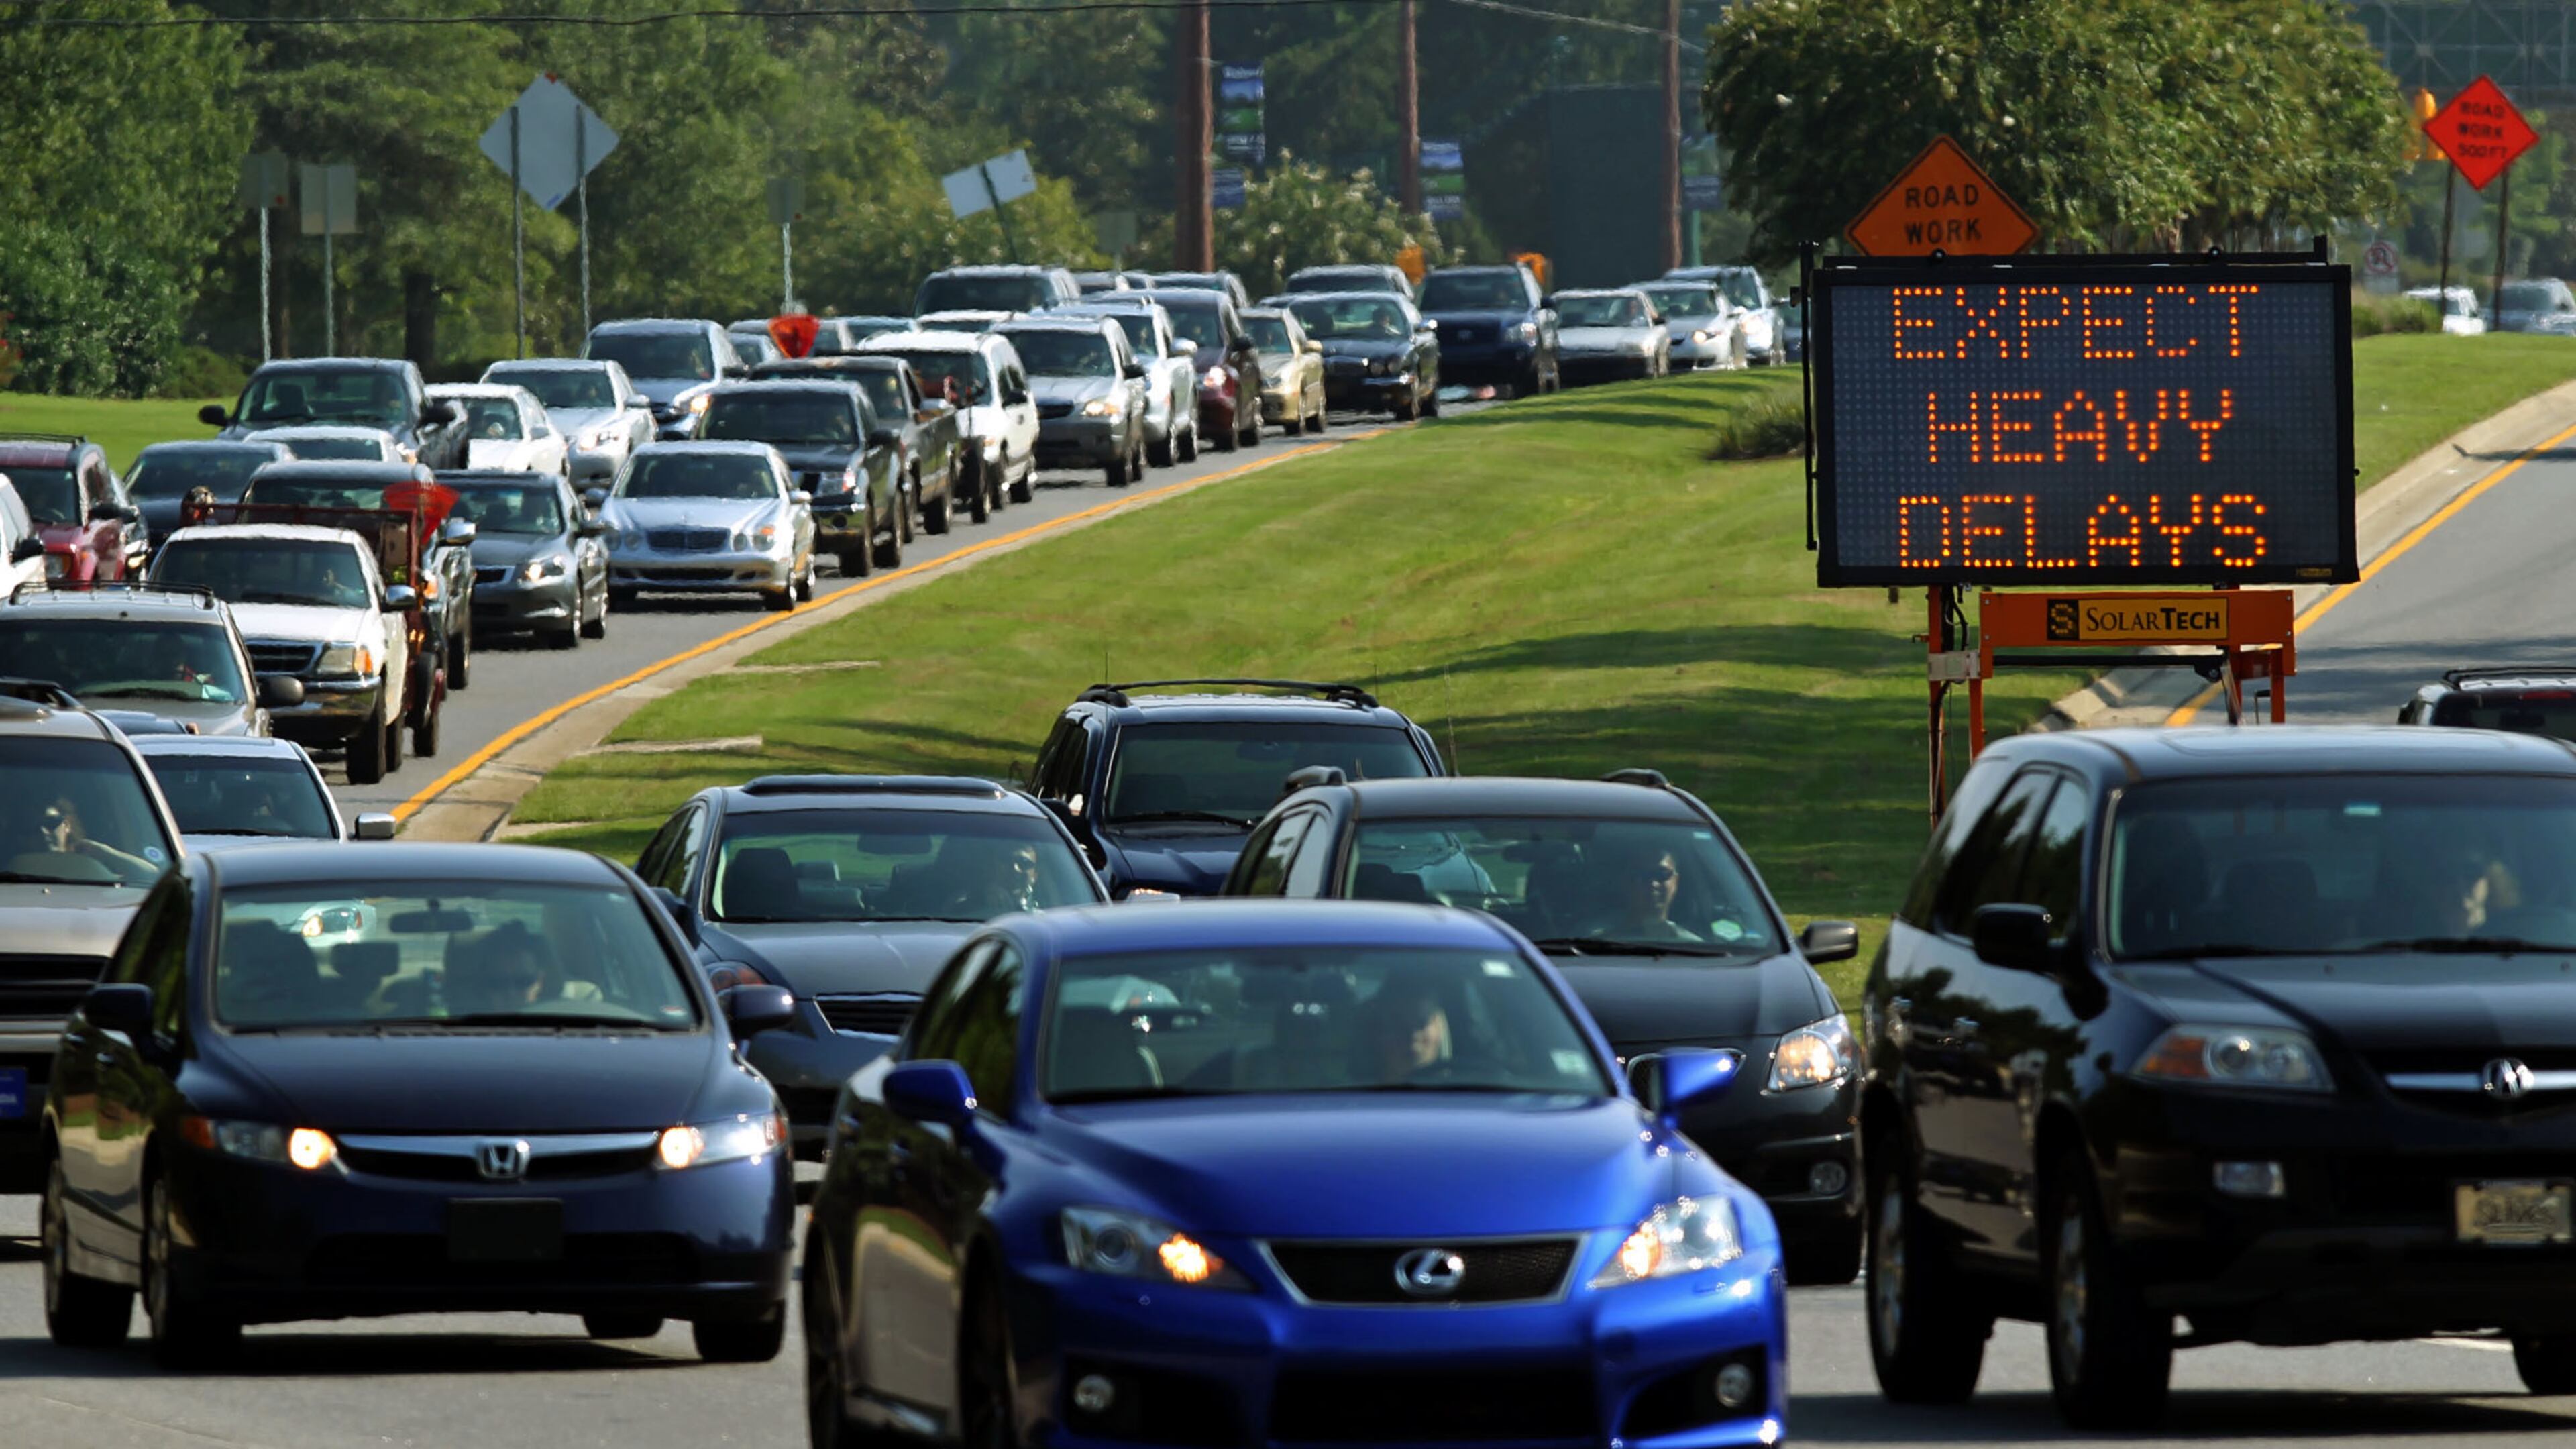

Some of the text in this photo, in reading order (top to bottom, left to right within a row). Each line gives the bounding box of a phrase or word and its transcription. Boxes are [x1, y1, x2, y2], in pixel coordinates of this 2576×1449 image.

[2460, 102, 2505, 119] ROAD
[2457, 122, 2504, 140] WORK
[1905, 184, 1980, 209] ROAD
[1904, 218, 1982, 246] WORK
[1893, 285, 2259, 359] EXPECT
[1928, 388, 2233, 463] HEAVY
[1899, 494, 2267, 568] DELAYS
